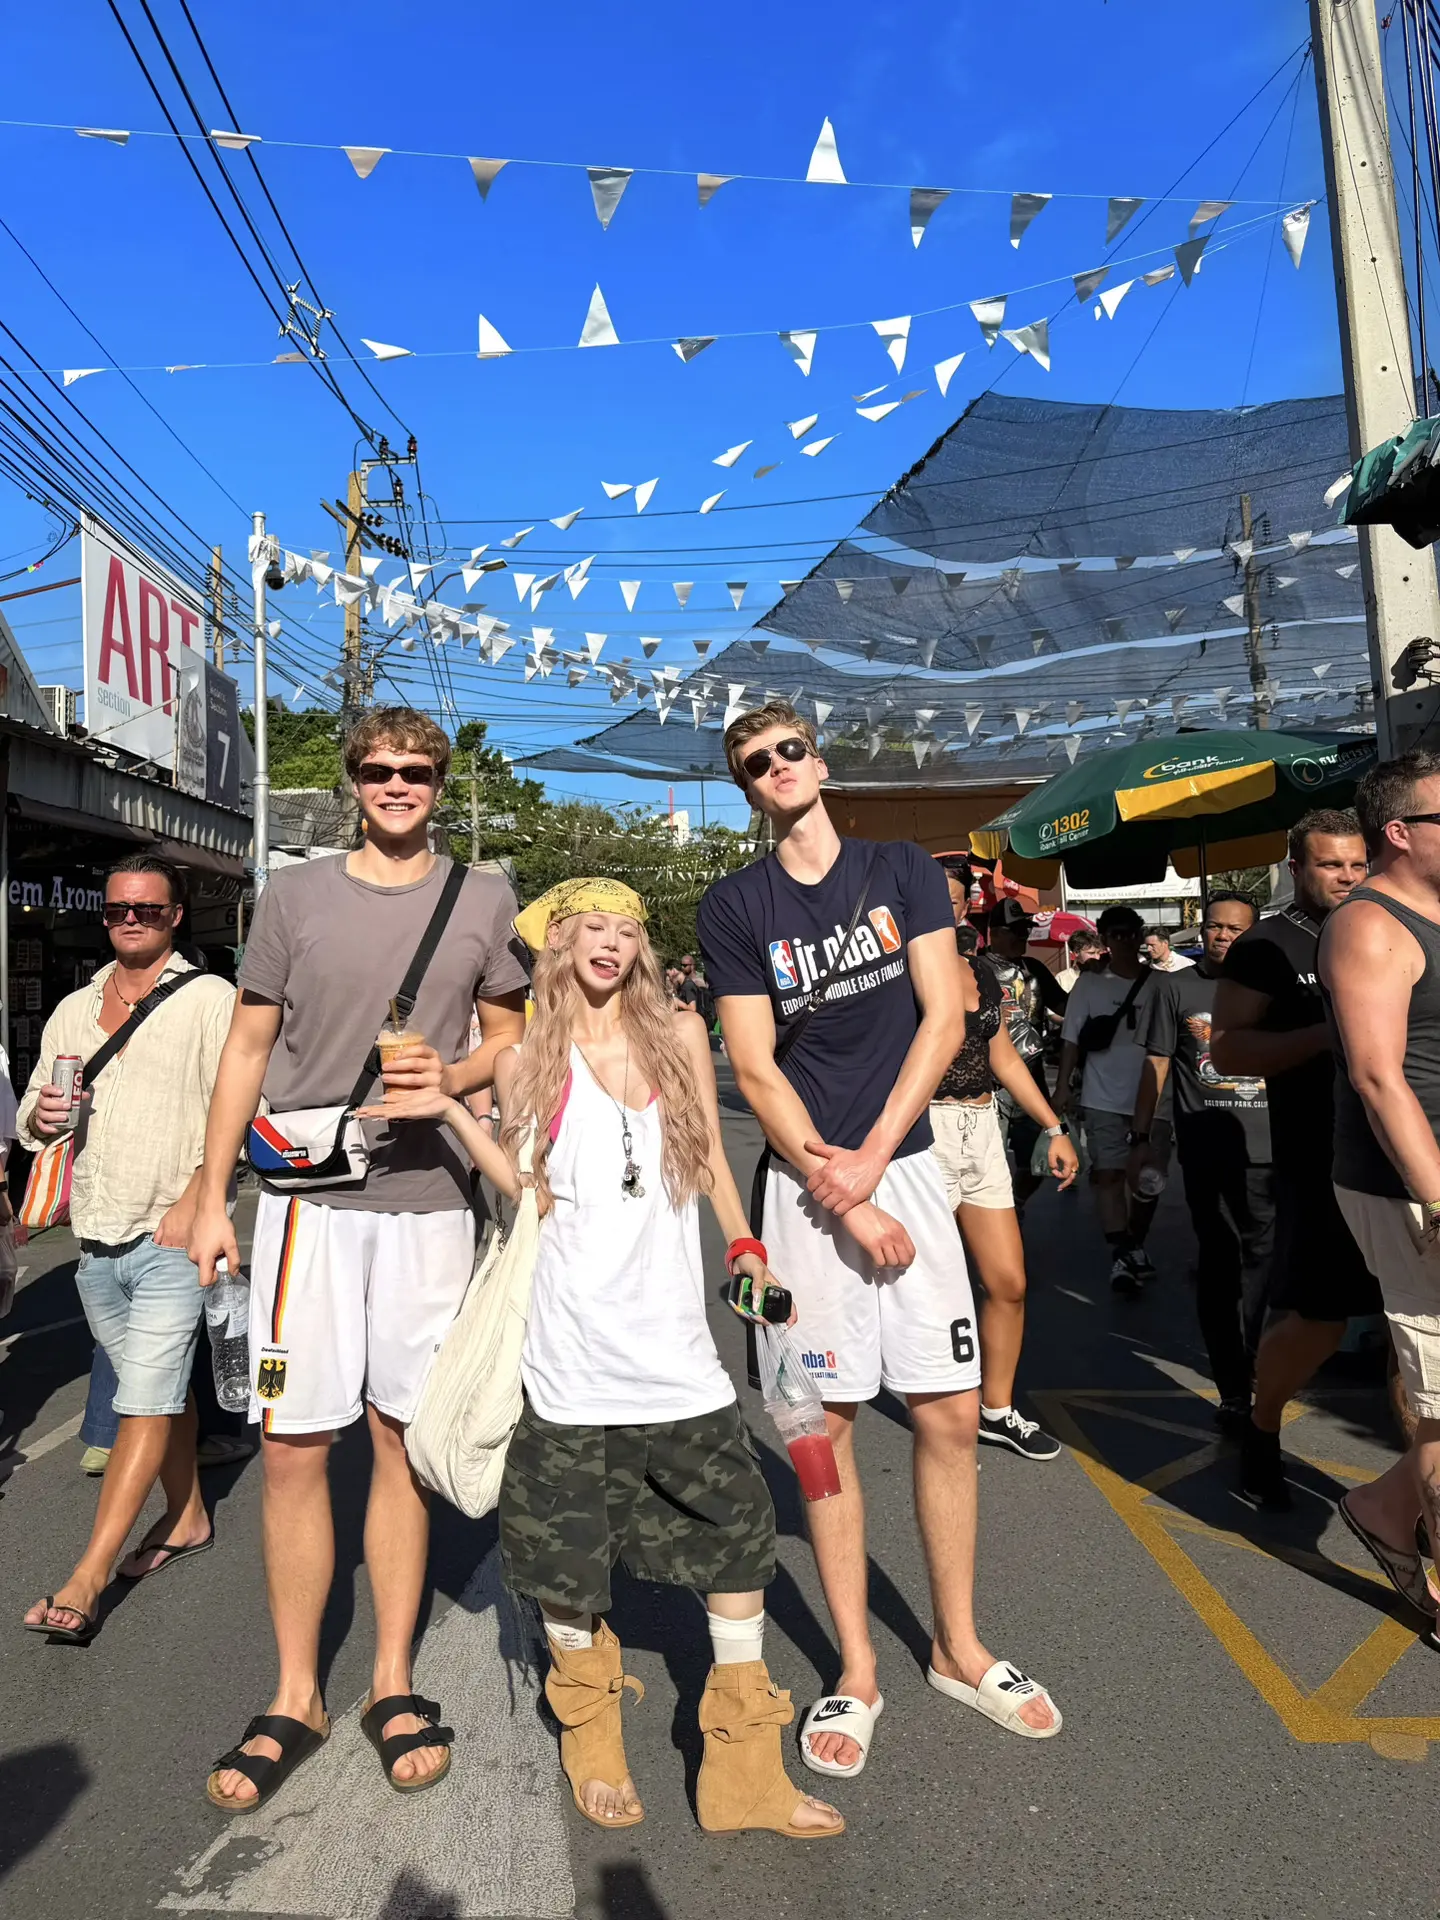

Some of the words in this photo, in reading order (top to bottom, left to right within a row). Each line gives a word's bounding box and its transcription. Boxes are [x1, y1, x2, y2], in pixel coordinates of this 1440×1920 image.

[98, 687, 131, 717] section
[217, 730, 230, 789] 7
[1052, 809, 1090, 835] 1302
[9, 880, 43, 907] em
[825, 980, 859, 1001] MIDDLE
[858, 971, 882, 991] EAST
[881, 958, 905, 983] FINALS
[1296, 973, 1317, 985] AR
[950, 1318, 975, 1363] 6
[821, 1699, 853, 1714] NIKE
